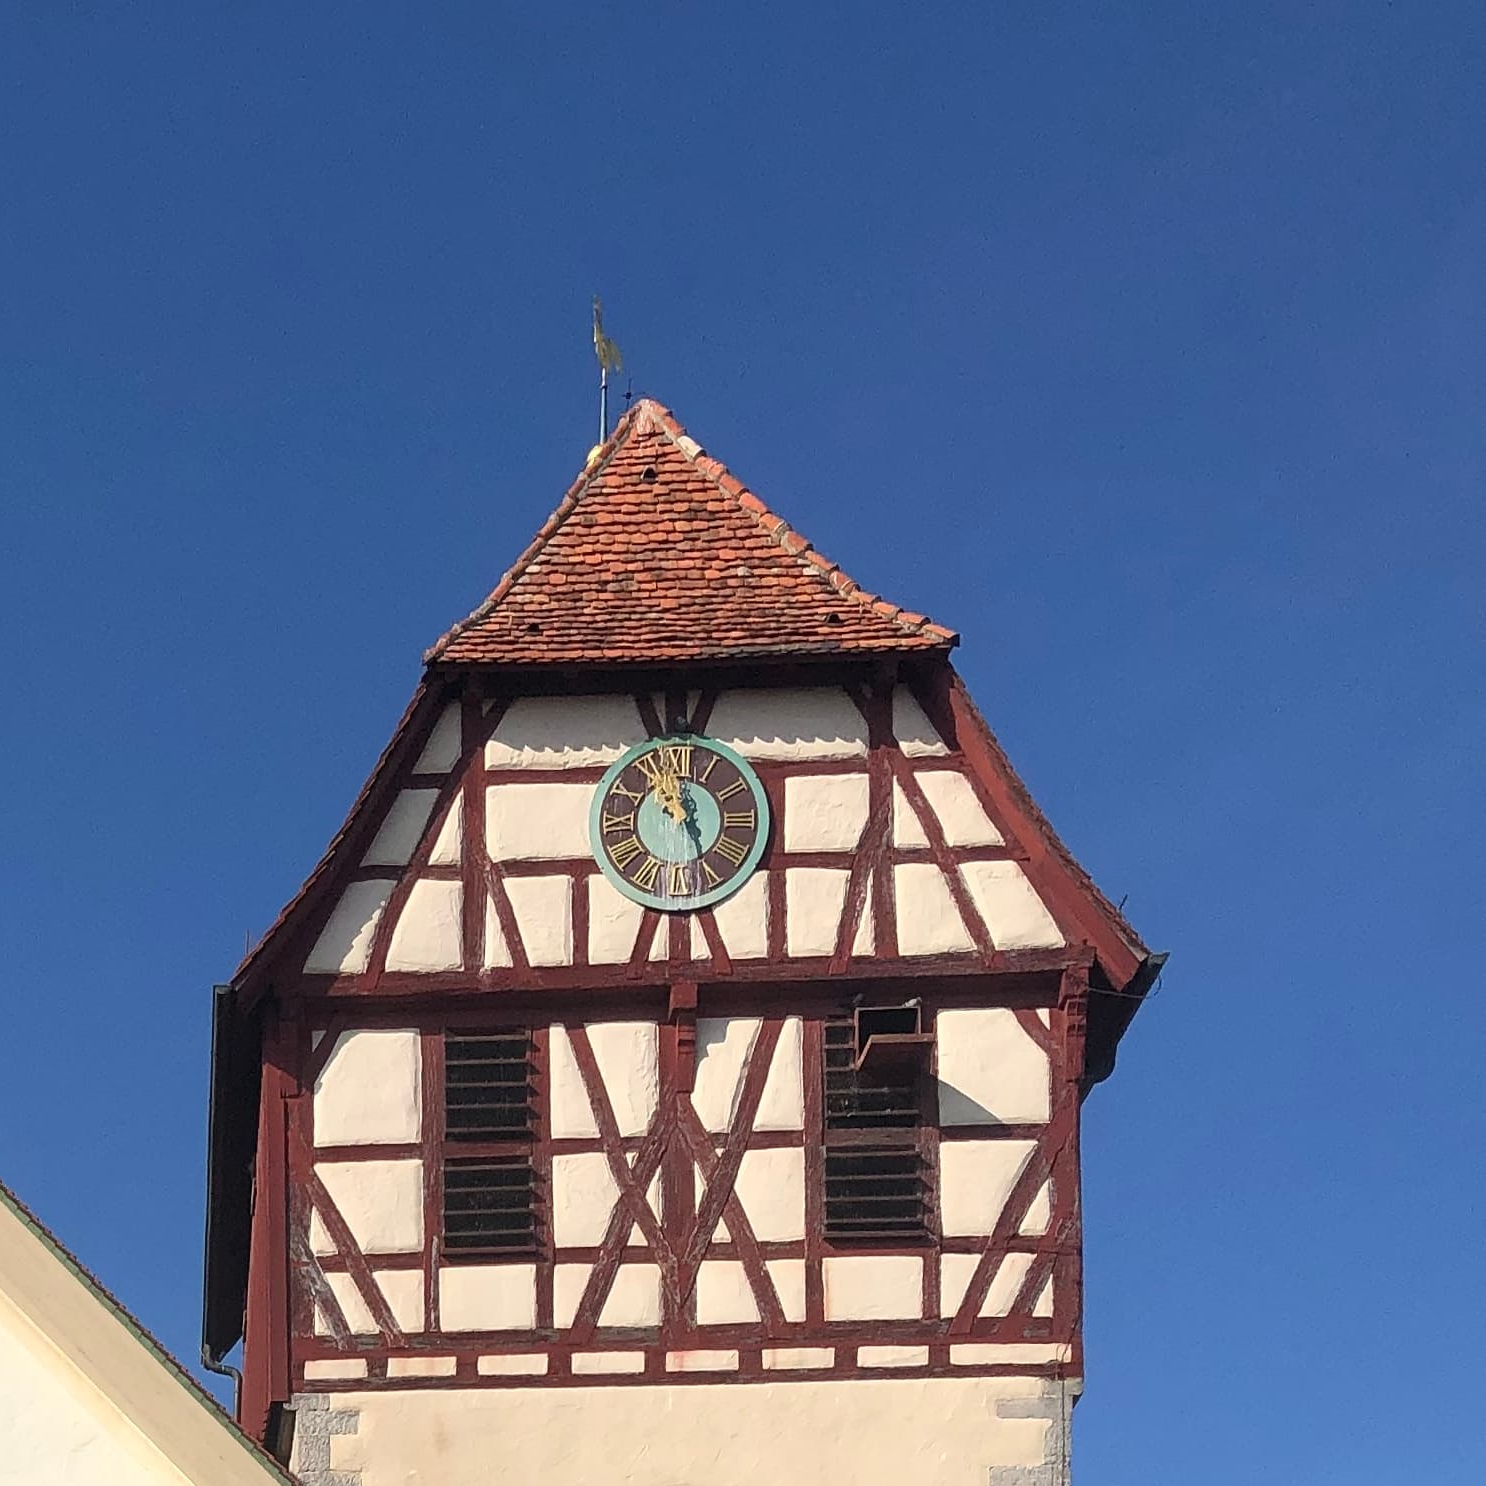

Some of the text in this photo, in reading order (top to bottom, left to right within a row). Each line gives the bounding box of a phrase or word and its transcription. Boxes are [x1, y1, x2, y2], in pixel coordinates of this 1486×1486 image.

[633, 751, 663, 788] XI
[665, 746, 695, 778] XII
[699, 755, 722, 784] I
[610, 778, 644, 807] X
[716, 777, 748, 803] II
[603, 809, 634, 835] IX
[724, 810, 754, 830] III
[607, 834, 646, 872] VIII
[713, 833, 750, 868] IIII
[629, 855, 664, 892] VII
[668, 864, 693, 896] VI
[697, 858, 724, 888] V
